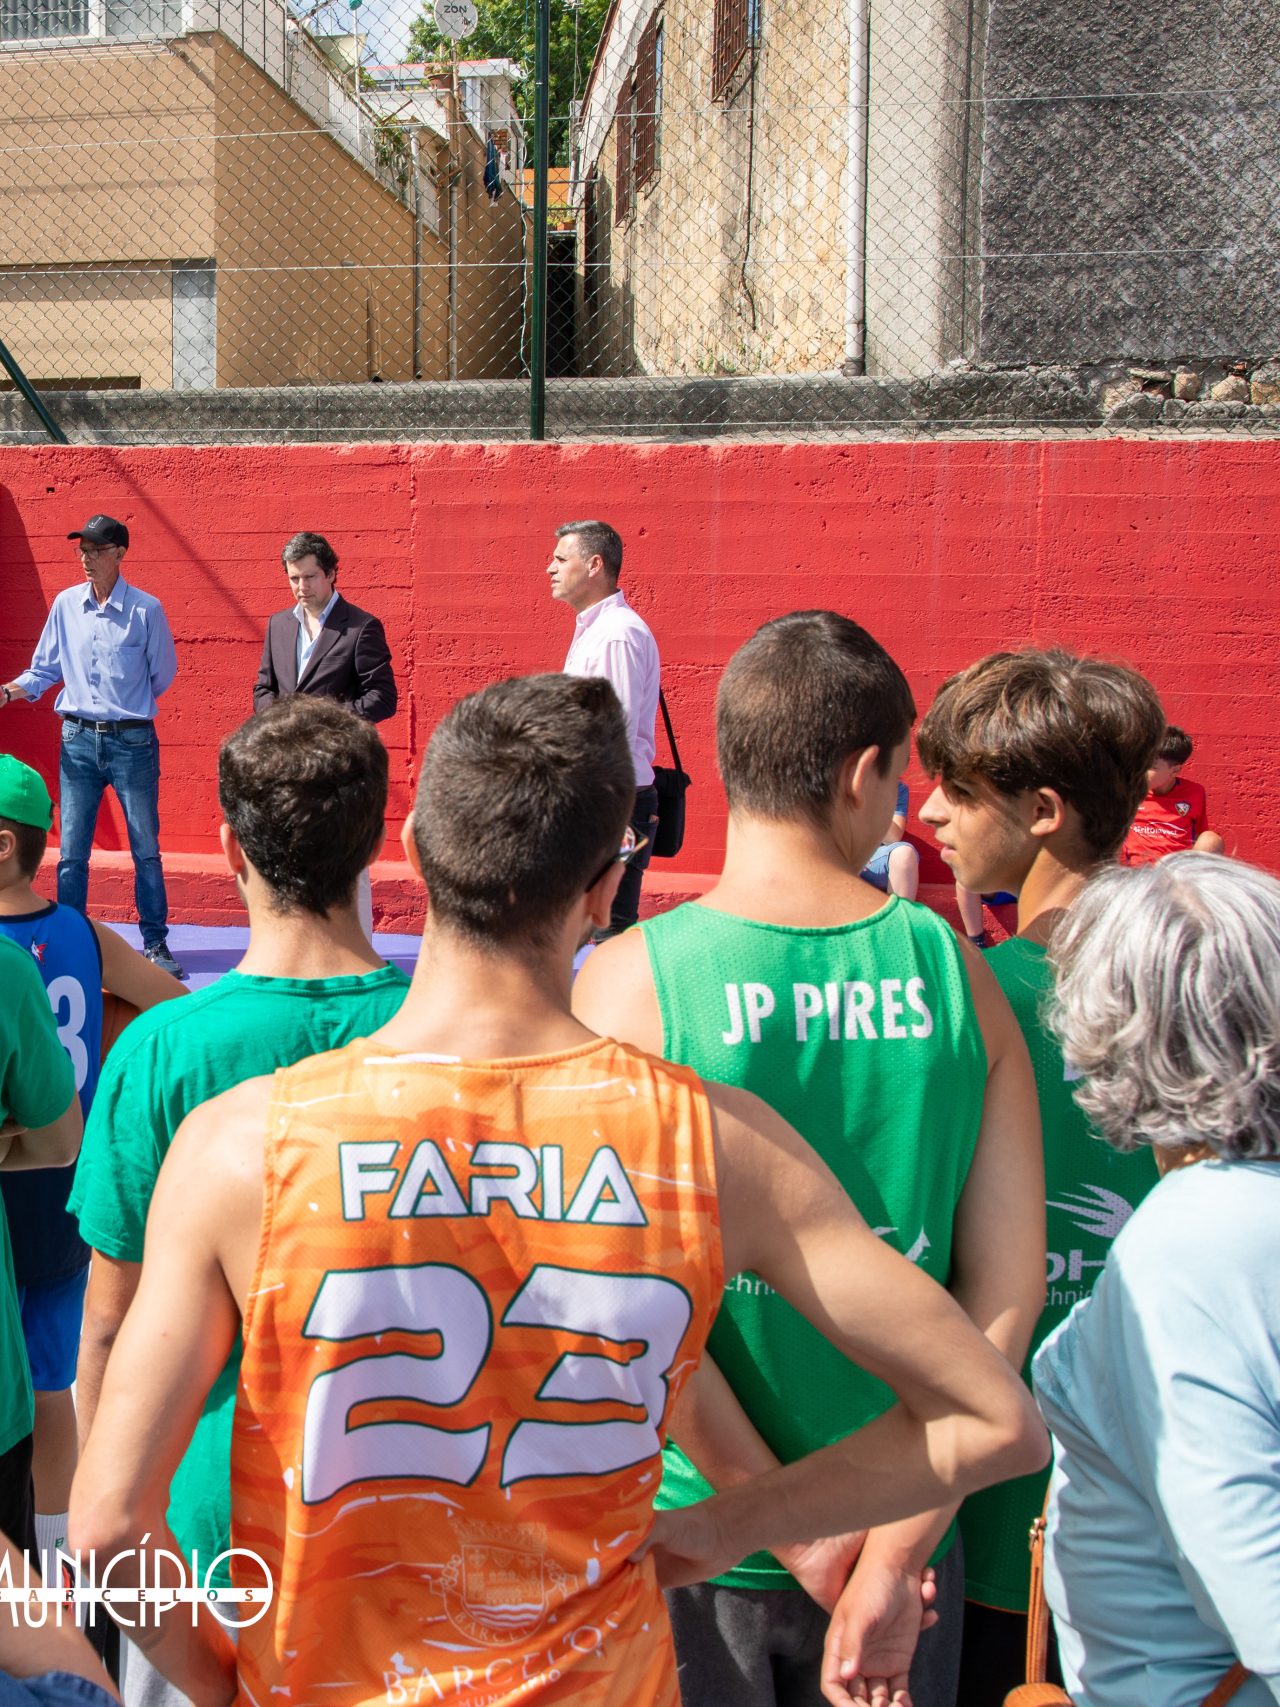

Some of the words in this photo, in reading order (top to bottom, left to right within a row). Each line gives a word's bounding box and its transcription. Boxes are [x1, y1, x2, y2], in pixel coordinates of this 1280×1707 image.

[443, 5, 467, 14] ZON
[722, 982, 775, 1045] JP
[792, 976, 934, 1041] PIRES
[338, 1139, 649, 1227] FARIA
[301, 1260, 694, 1506] 23
